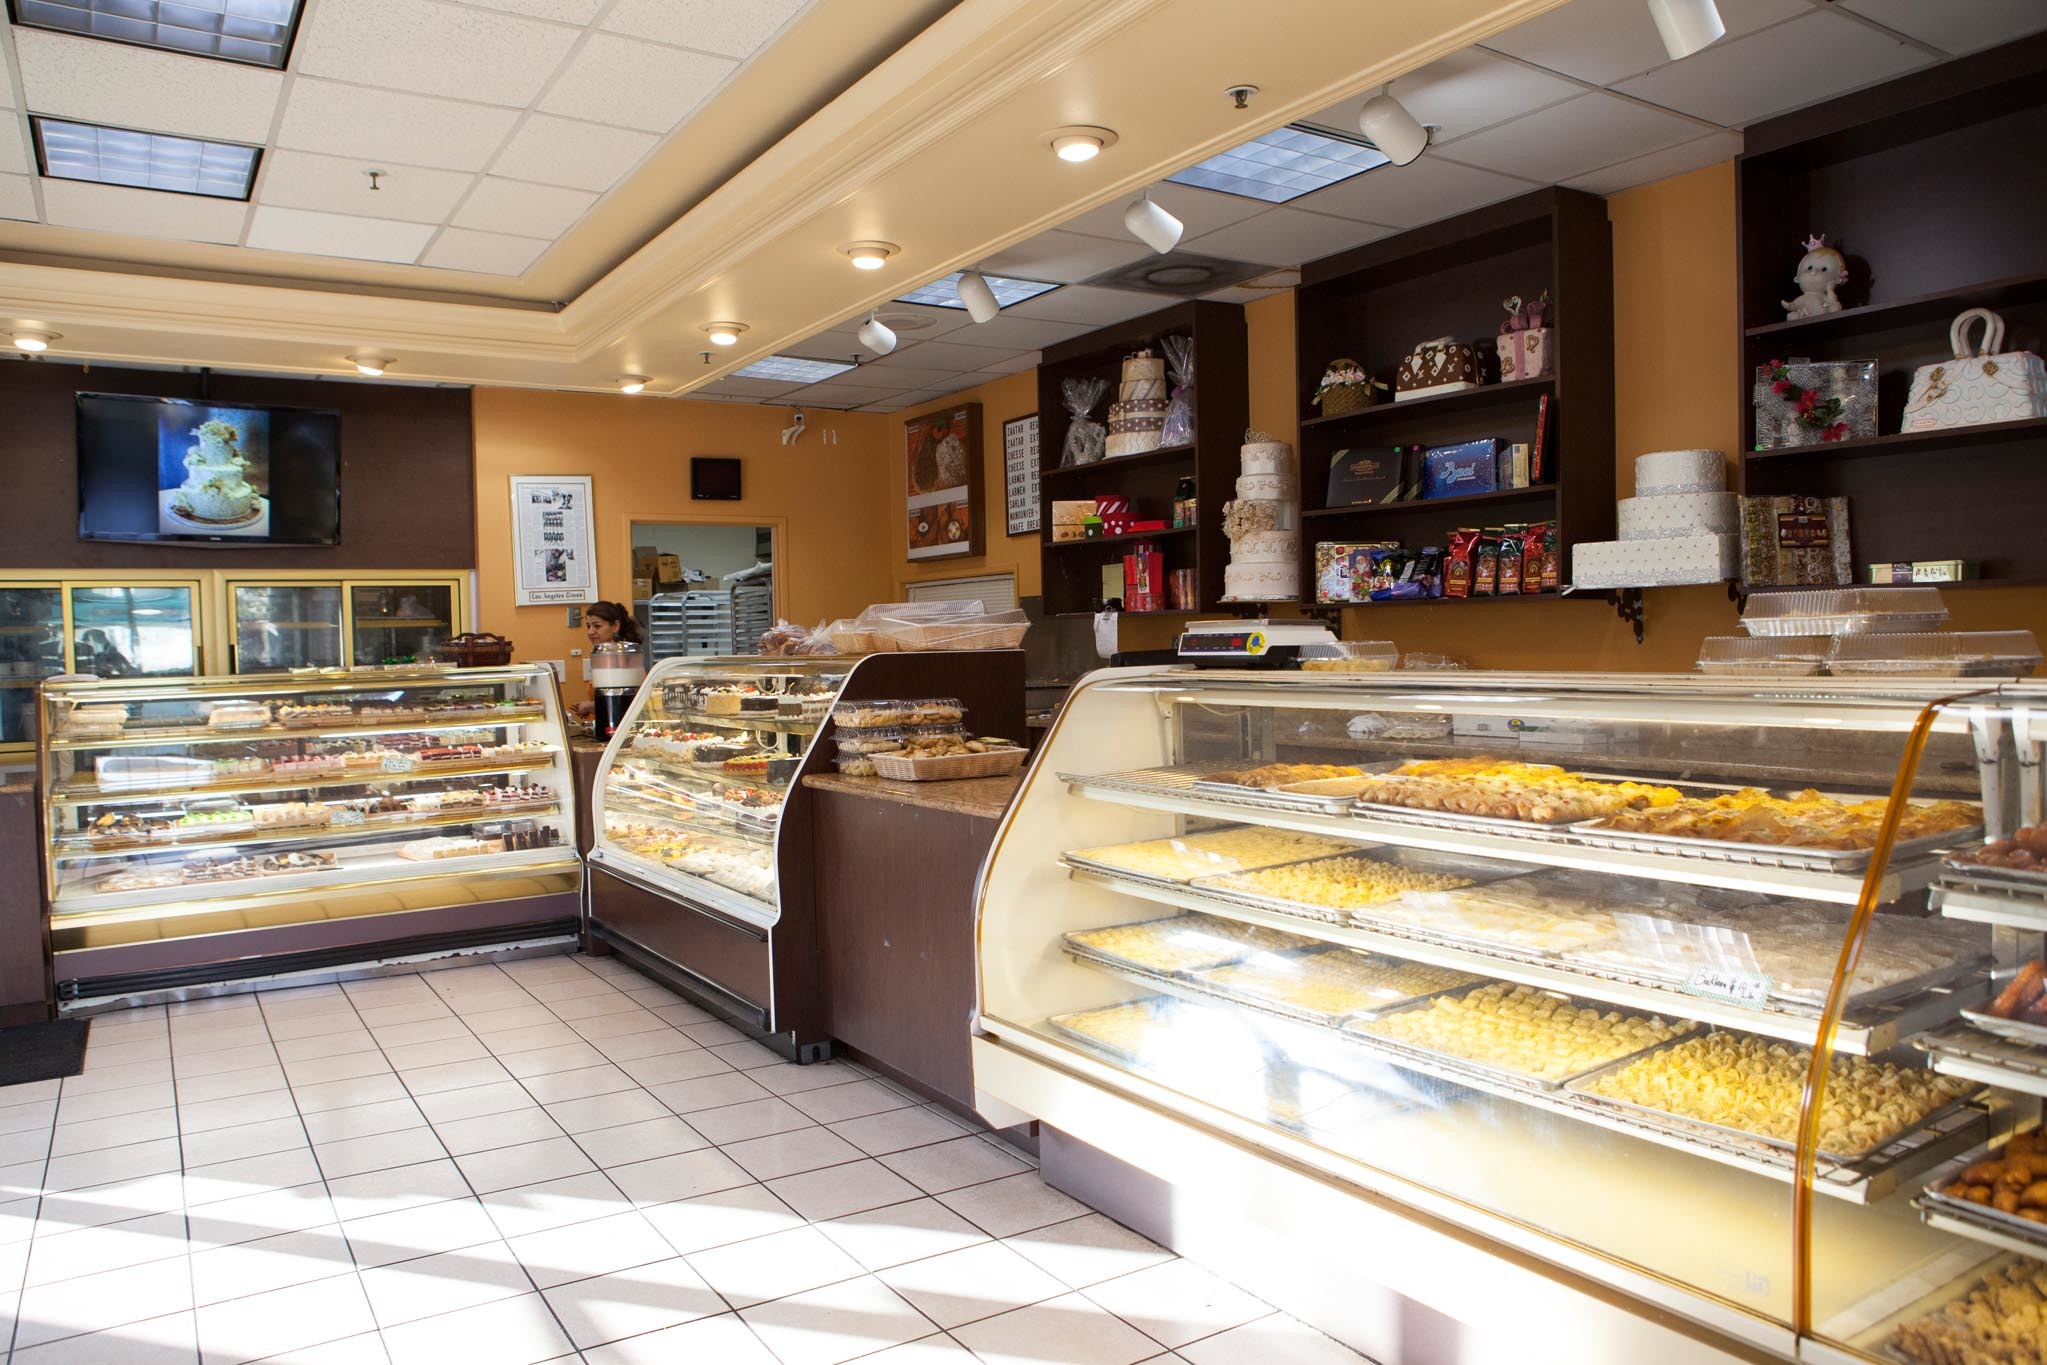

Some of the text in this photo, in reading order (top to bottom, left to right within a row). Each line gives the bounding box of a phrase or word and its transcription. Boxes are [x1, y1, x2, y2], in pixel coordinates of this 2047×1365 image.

[1007, 424, 1024, 437] ZAATAR
[1007, 436, 1024, 449] ZAATAR
[1008, 448, 1024, 461] CHEESE
[1008, 461, 1025, 473] CHEESE
[1010, 497, 1026, 509] SAHLAB
[543, 592, 565, 600] Angeles
[565, 591, 583, 599] Times
